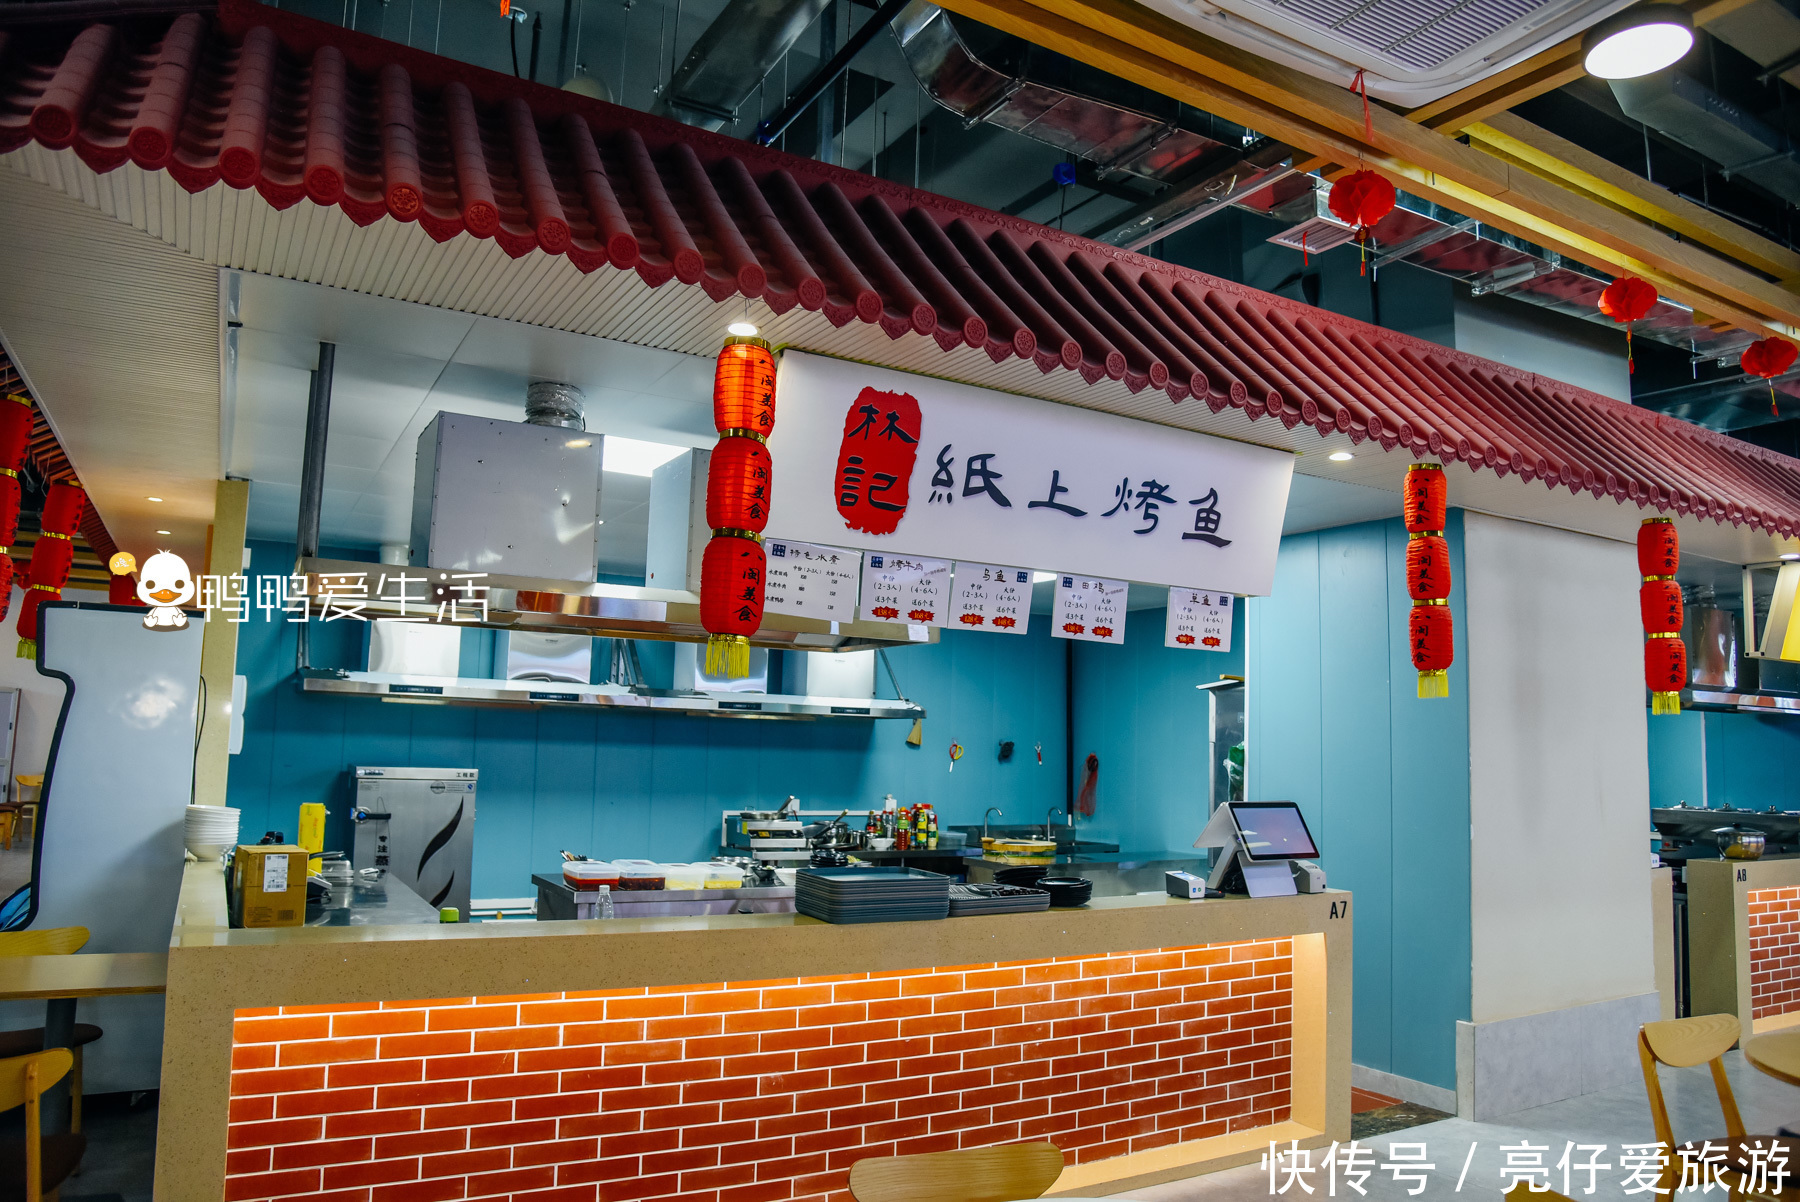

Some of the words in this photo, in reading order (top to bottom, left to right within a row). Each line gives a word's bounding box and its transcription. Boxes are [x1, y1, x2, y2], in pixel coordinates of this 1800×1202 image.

[840, 404, 919, 512] 林記
[733, 552, 763, 622] 八闽美食
[1736, 868, 1747, 882] A8
[1329, 901, 1347, 919] A7
